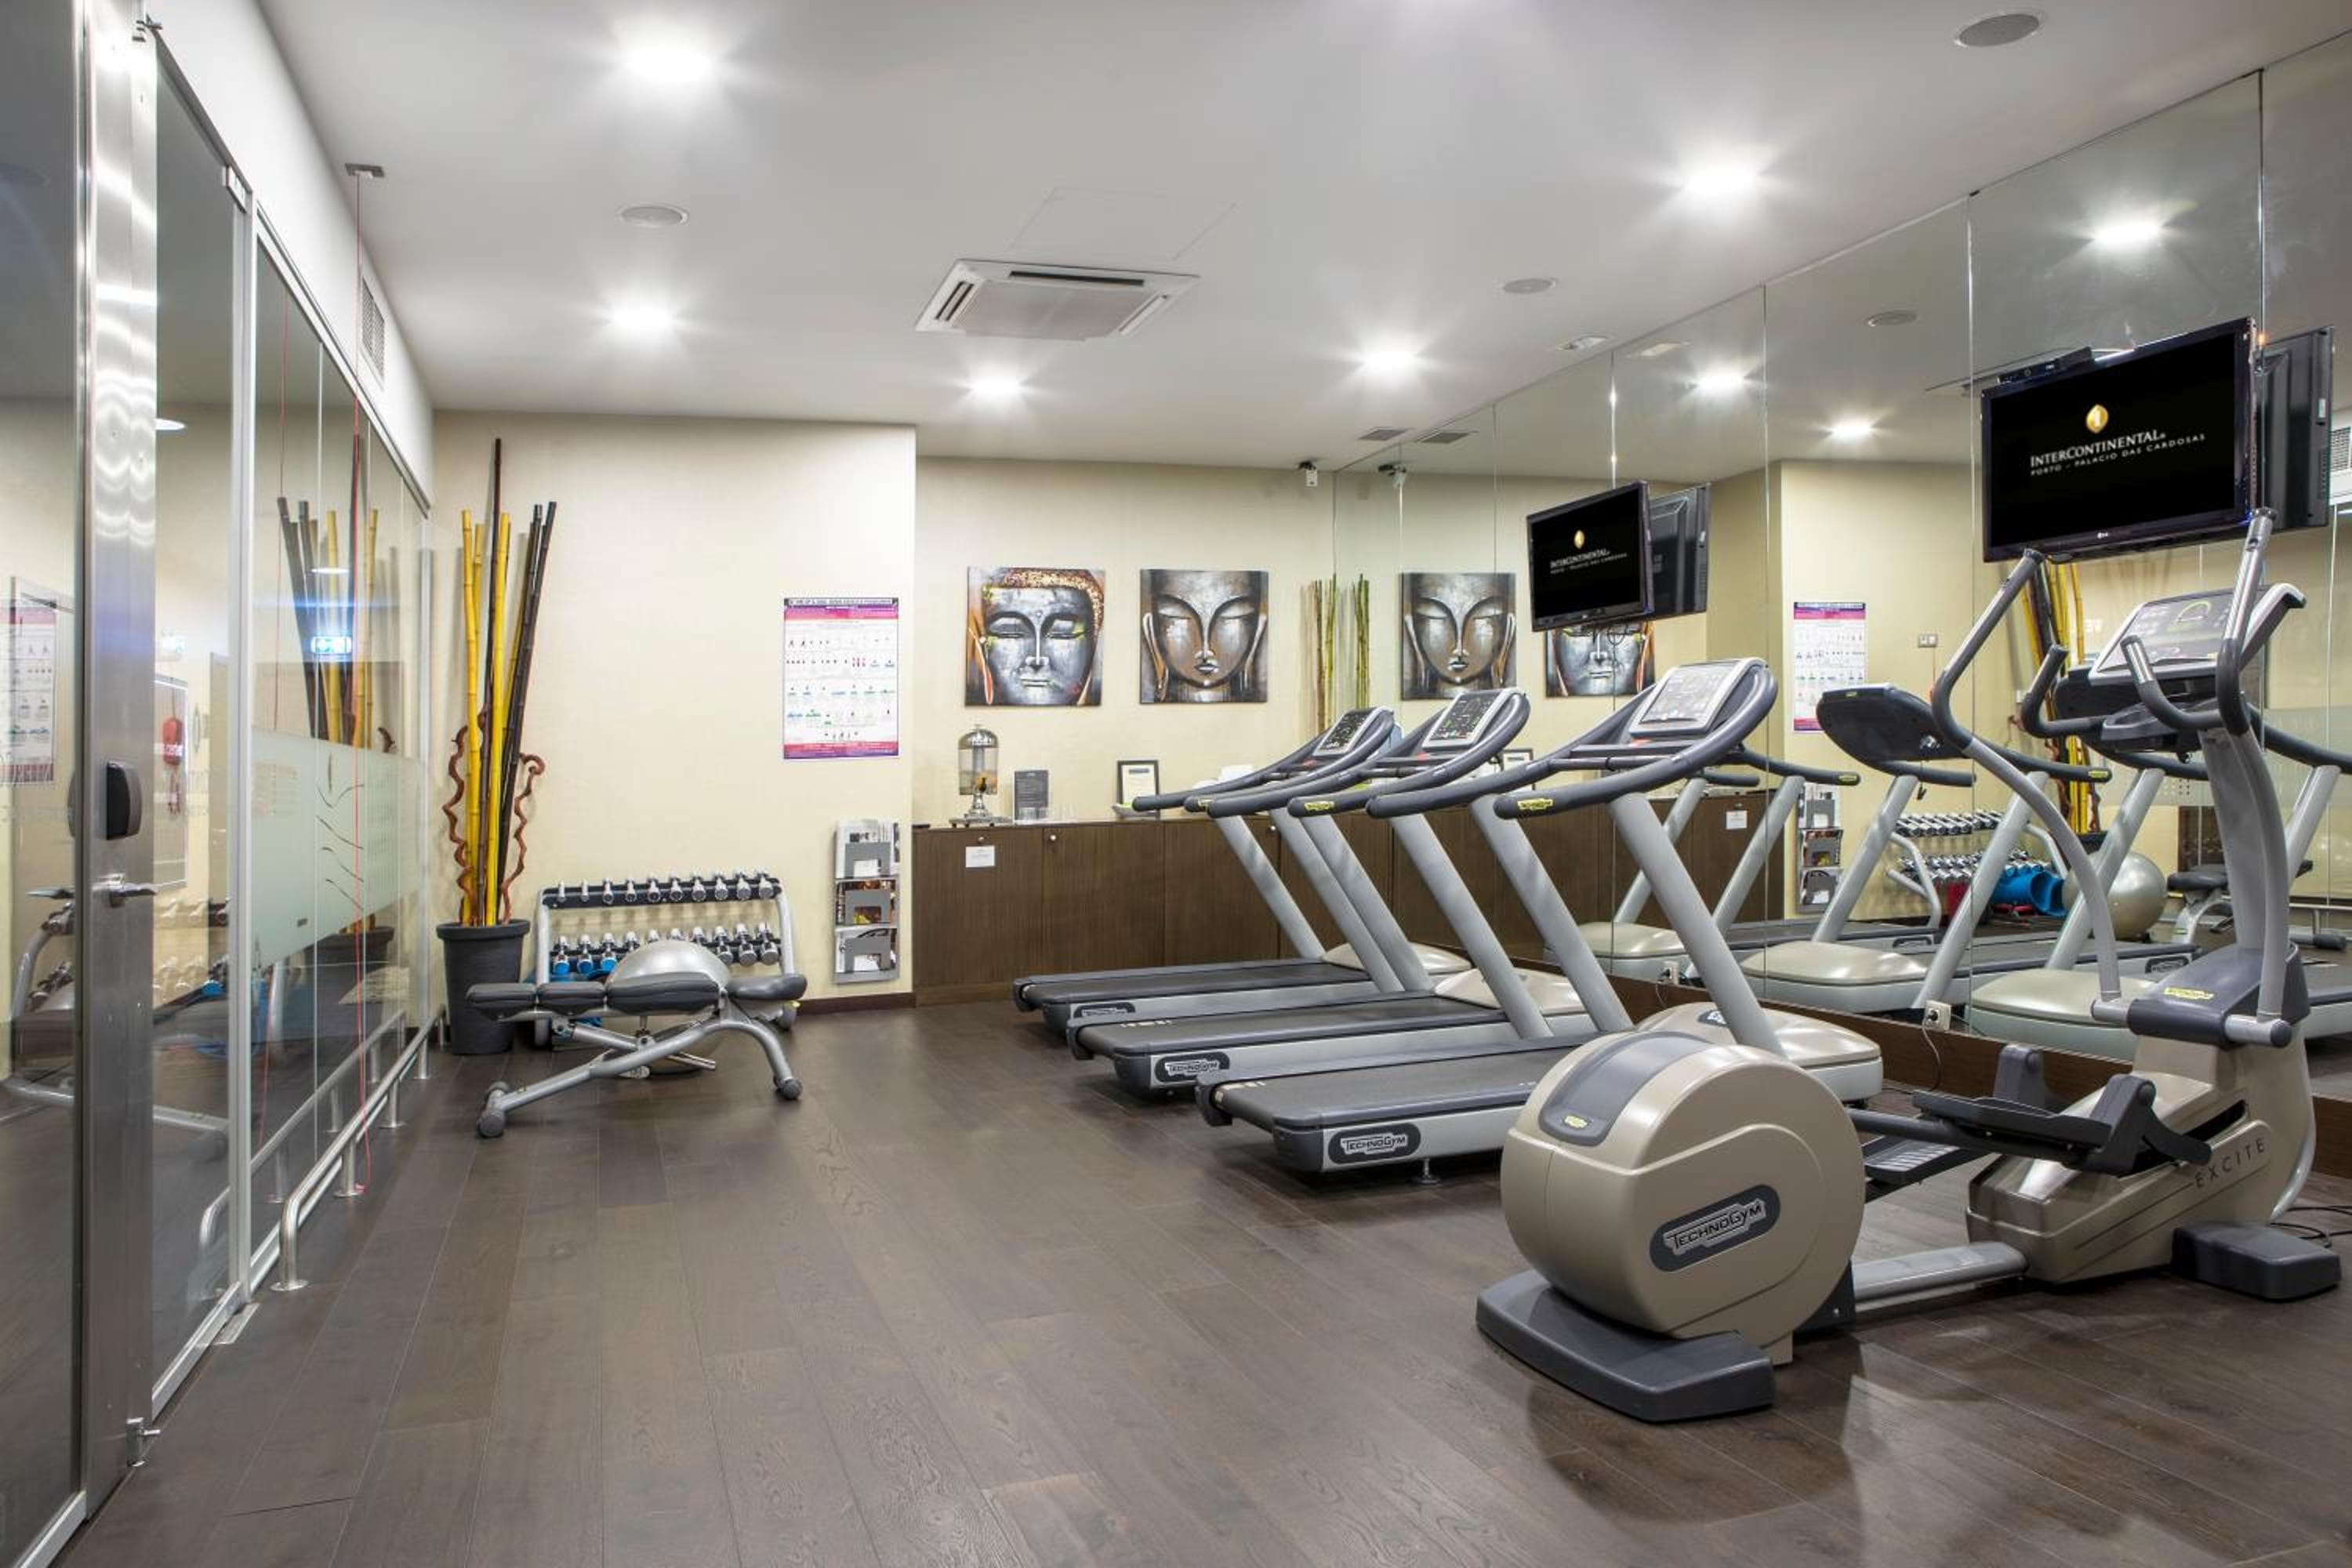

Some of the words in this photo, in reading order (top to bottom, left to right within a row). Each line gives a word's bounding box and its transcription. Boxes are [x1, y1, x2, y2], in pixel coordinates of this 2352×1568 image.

[2030, 430, 2160, 468] INTERCONTINENTAL
[2031, 463, 2062, 476] PORTO
[2074, 452, 2118, 467] PALACIO
[2122, 448, 2143, 458] DAS
[2146, 433, 2205, 452] CARDOSAS
[1341, 1134, 1407, 1152] TECHNOGYM
[2195, 1138, 2265, 1189] EXCITE
[1665, 1204, 1762, 1250] TECHNOGYM
